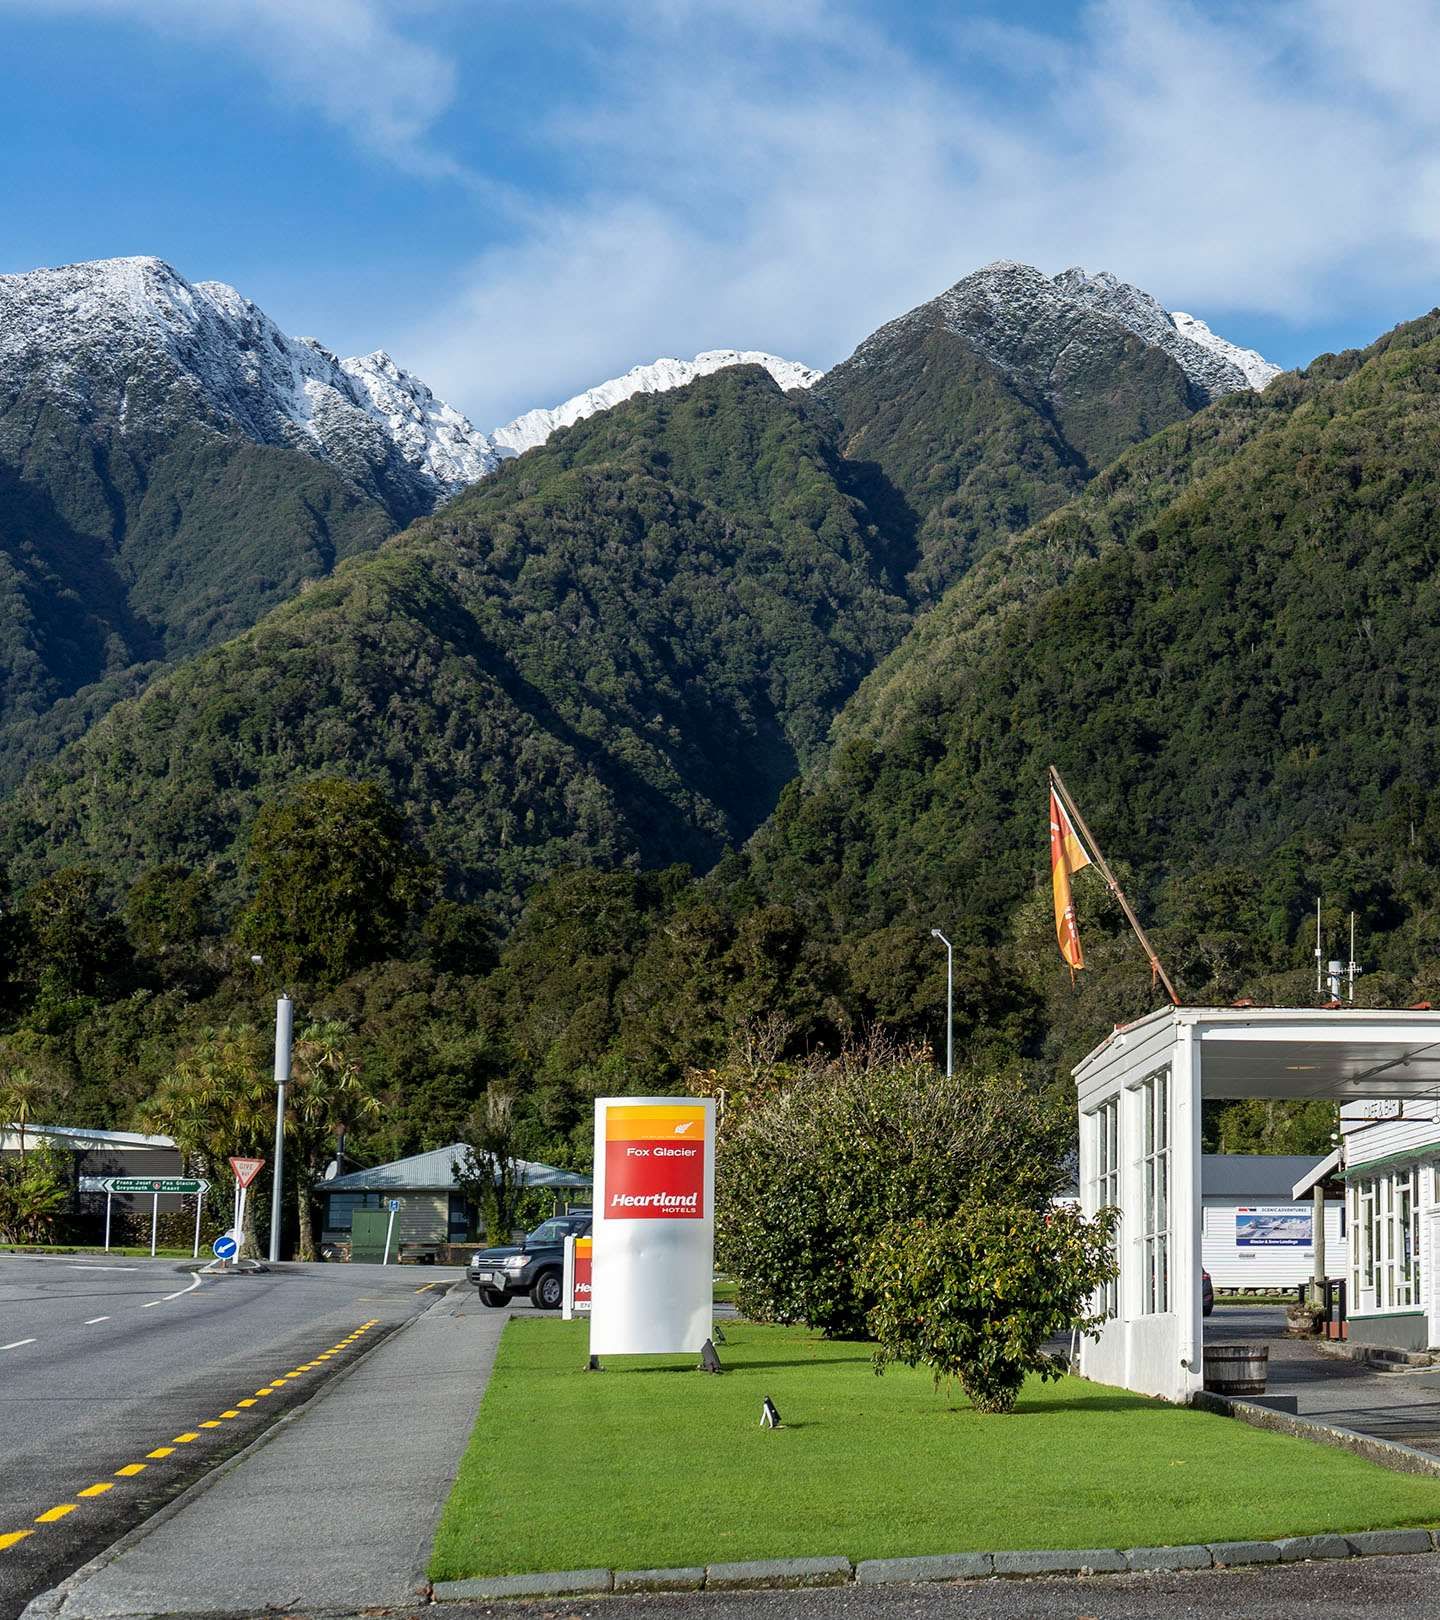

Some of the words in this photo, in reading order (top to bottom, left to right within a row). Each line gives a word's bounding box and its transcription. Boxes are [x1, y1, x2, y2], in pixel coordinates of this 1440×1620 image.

[626, 1147, 649, 1156] Fox
[653, 1147, 697, 1157] Glacier
[611, 1192, 698, 1207] Heartland
